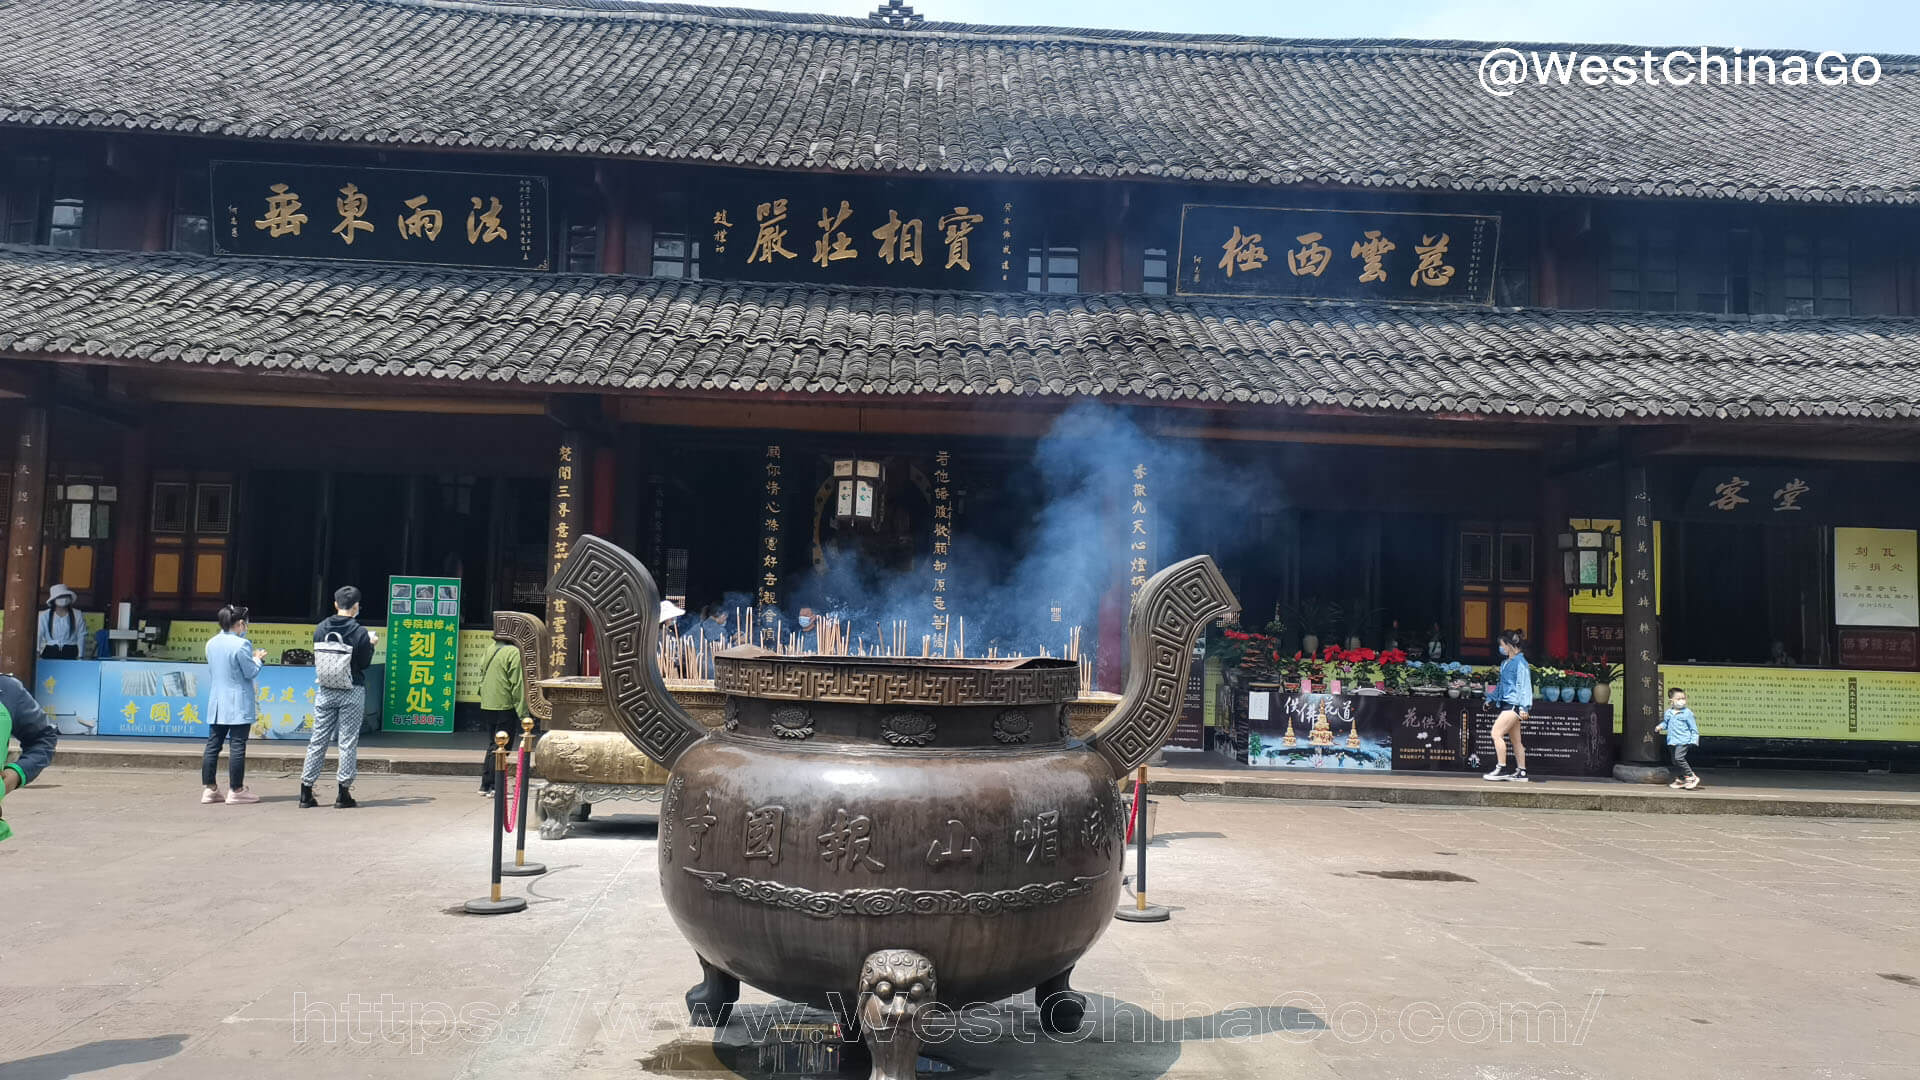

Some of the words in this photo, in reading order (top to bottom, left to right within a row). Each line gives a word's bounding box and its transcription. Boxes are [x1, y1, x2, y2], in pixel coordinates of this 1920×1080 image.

[1708, 476, 1811, 511] 客堂
[406, 631, 436, 713] 刻瓦处
[160, 724, 195, 734] TEMPLE
